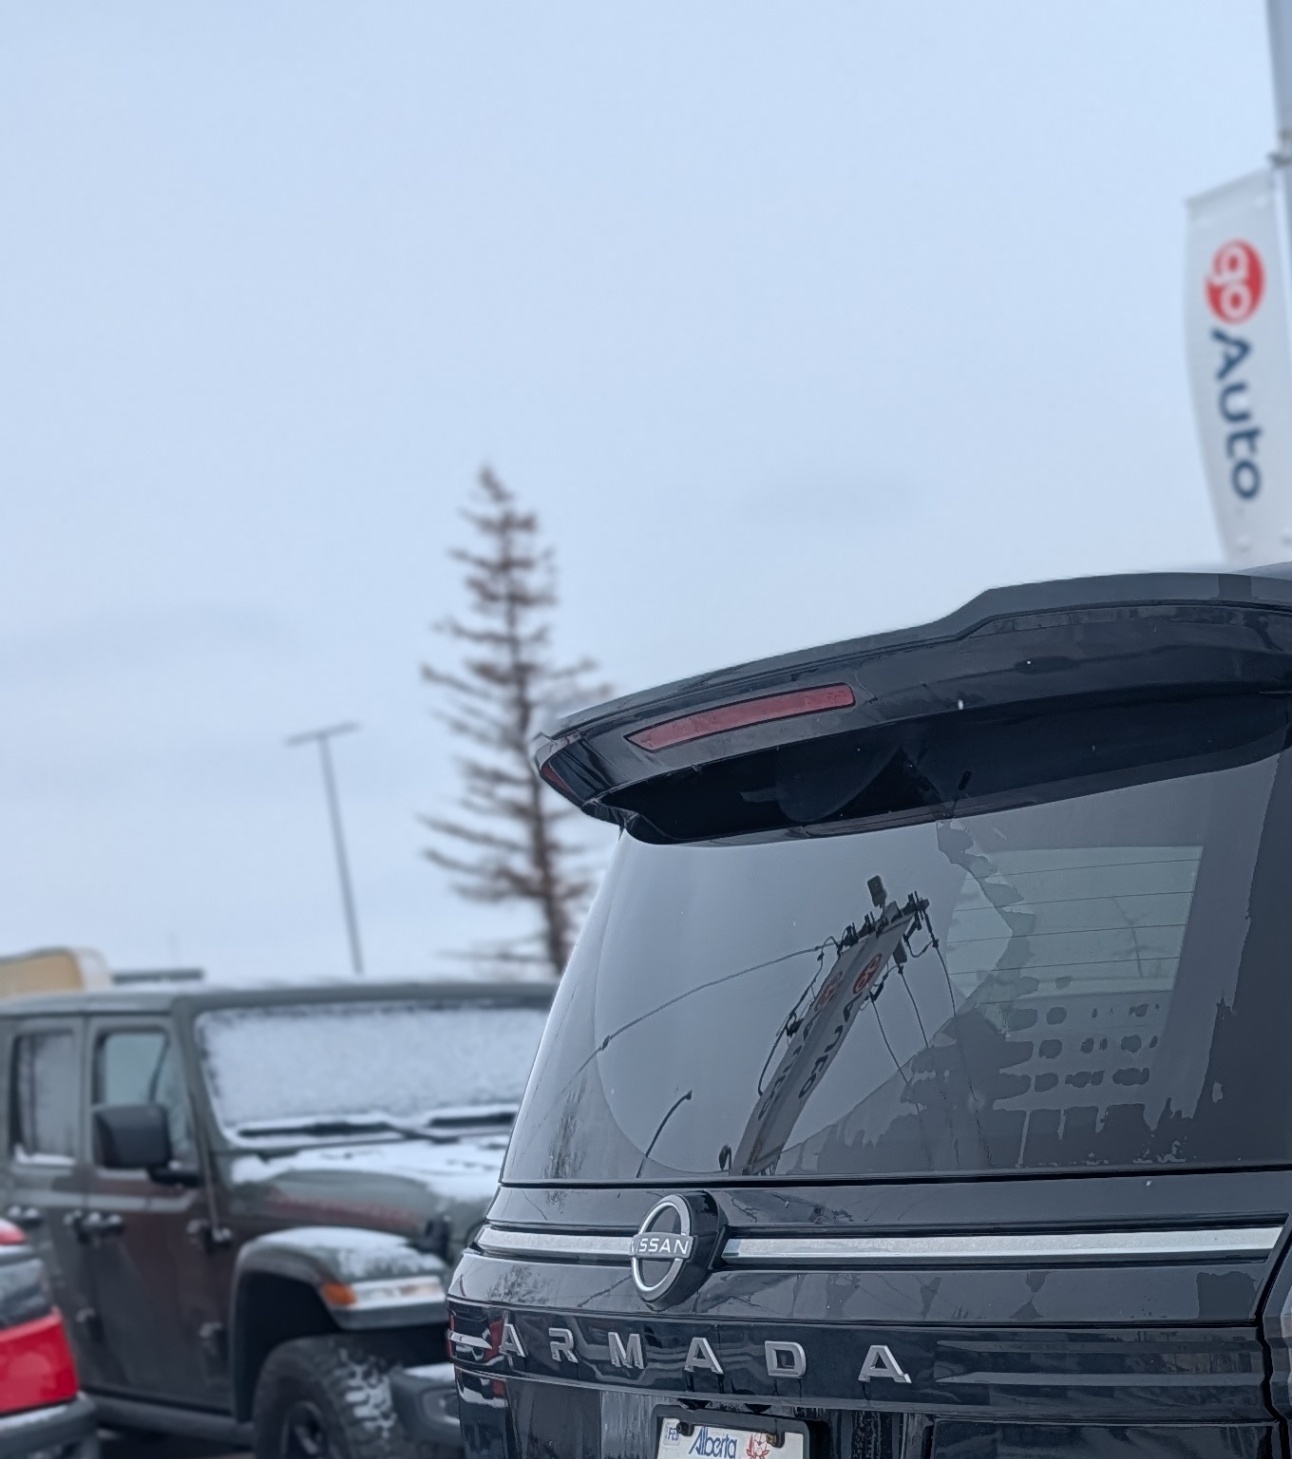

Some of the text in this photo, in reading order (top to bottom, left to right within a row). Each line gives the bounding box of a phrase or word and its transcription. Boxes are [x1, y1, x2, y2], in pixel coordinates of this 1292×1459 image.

[1211, 243, 1263, 502] go Auto
[499, 1323, 911, 1384] ARMADA
[689, 1427, 738, 1459] Alberta
